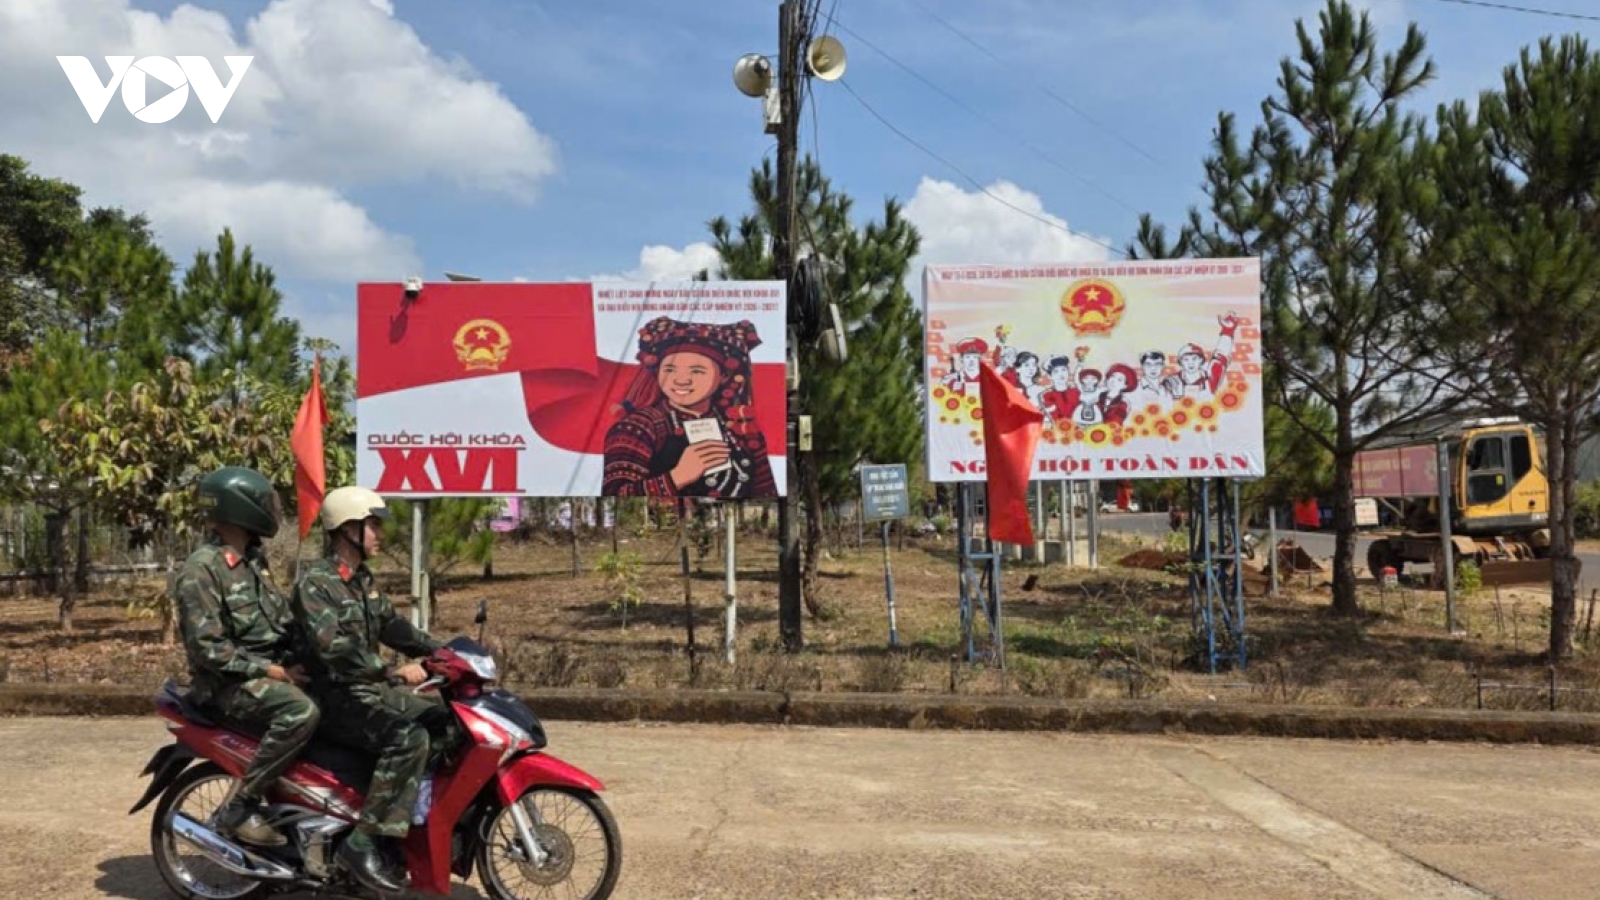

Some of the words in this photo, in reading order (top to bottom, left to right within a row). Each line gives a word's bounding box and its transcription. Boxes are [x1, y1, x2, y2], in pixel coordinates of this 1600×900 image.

[367, 430, 424, 445] QUỐC
[430, 432, 463, 447] HỘI
[469, 431, 526, 445] KHÓA
[375, 447, 517, 492] XVI
[950, 460, 986, 474] NG
[1038, 455, 1092, 475] HỘI
[1101, 453, 1179, 472] TOÀN
[1189, 452, 1249, 471] DÂN
